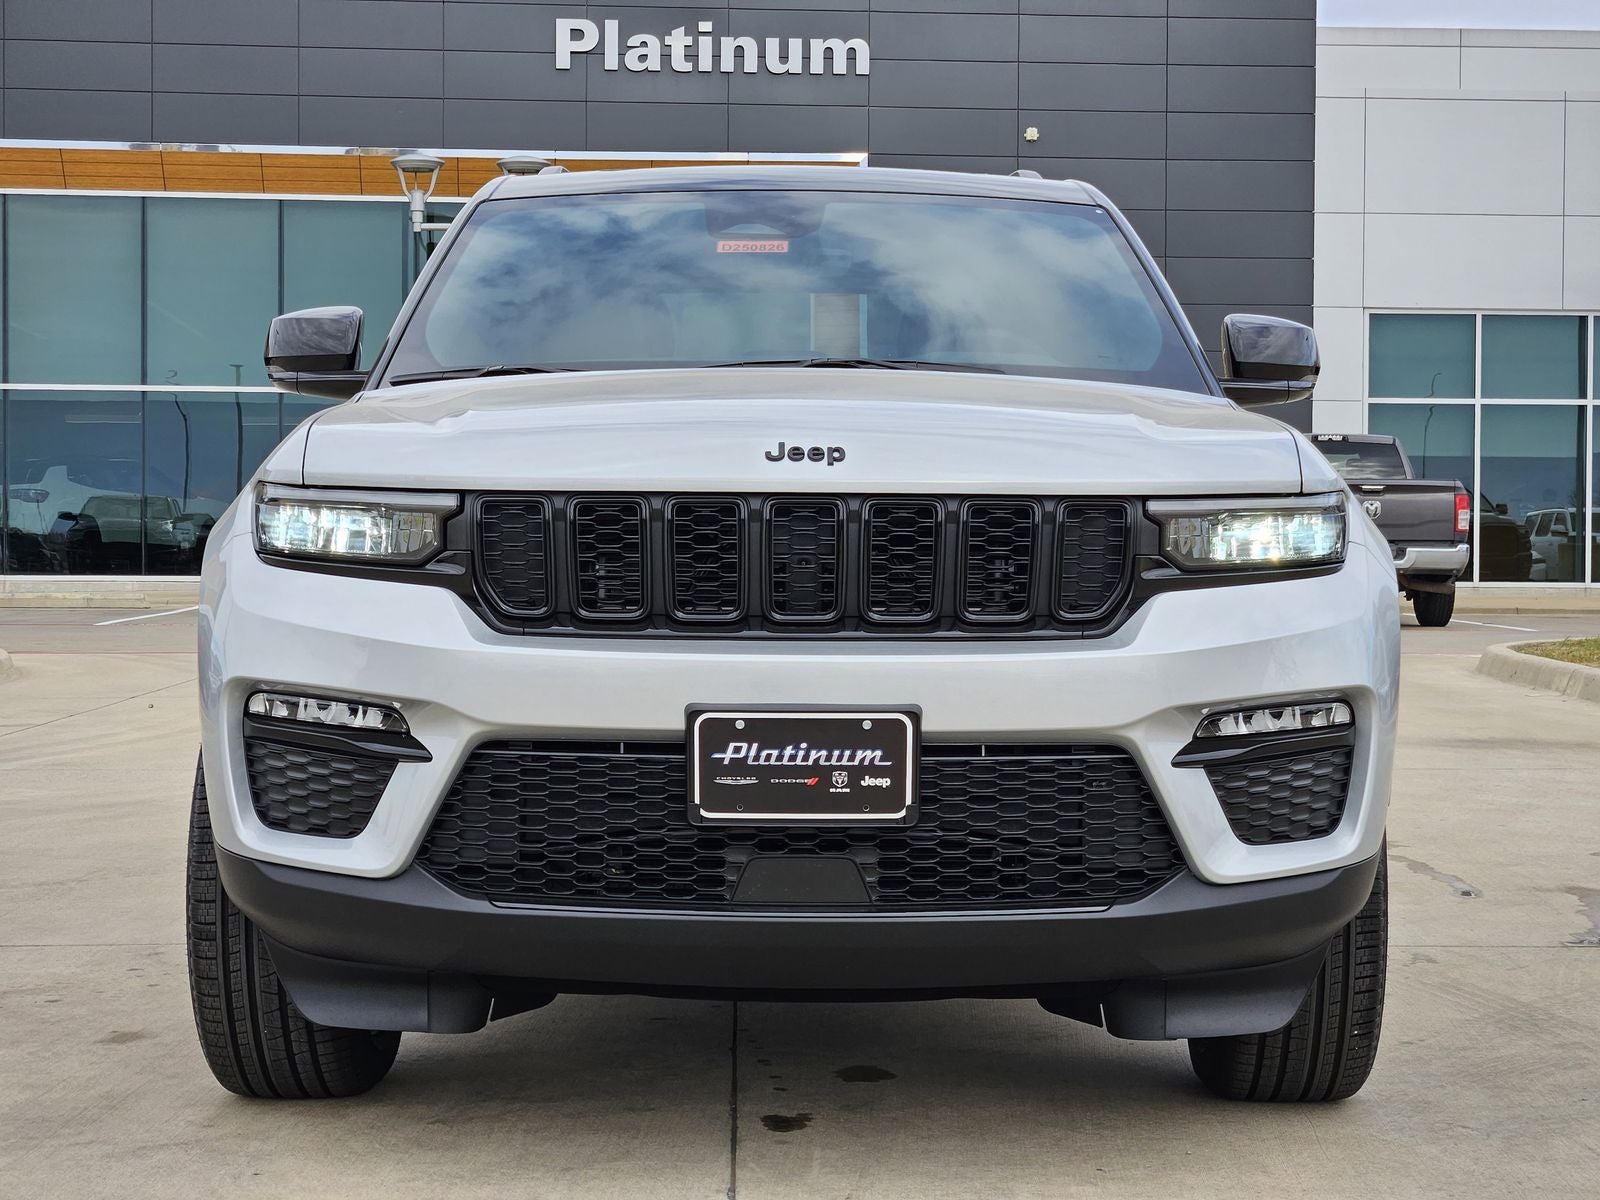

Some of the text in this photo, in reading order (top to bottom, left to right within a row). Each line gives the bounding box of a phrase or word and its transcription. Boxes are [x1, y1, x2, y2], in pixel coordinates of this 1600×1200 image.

[555, 18, 870, 75] Platinum
[721, 243, 785, 252] D250826
[765, 441, 846, 466] Jeep
[710, 742, 893, 766] Platinum
[860, 775, 891, 788] Jeep
